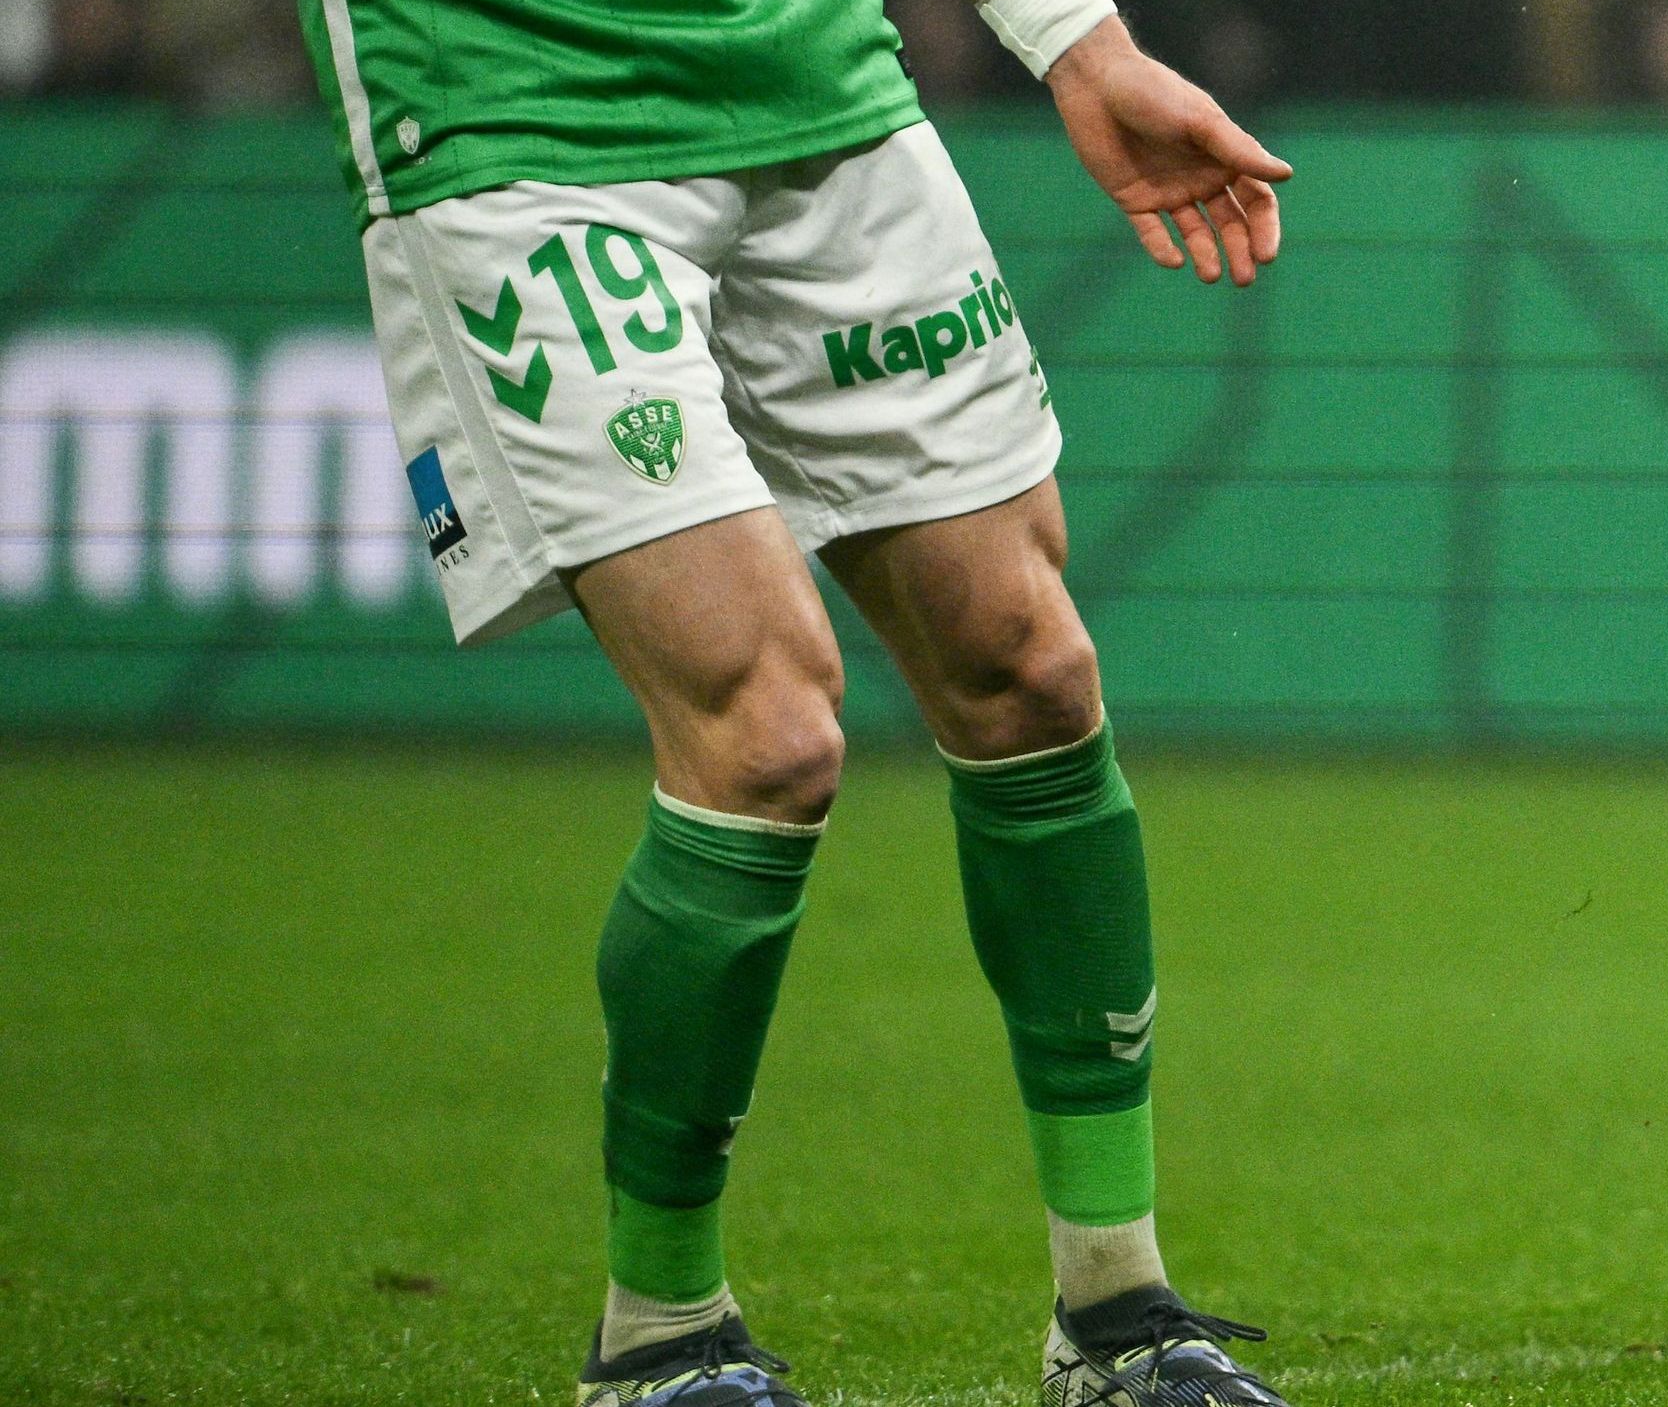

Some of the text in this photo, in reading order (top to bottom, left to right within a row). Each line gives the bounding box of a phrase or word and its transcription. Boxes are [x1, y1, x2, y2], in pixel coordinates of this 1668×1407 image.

[526, 221, 684, 376] 19
[822, 269, 1018, 389] Kaprio
[614, 405, 672, 440] ASSE
